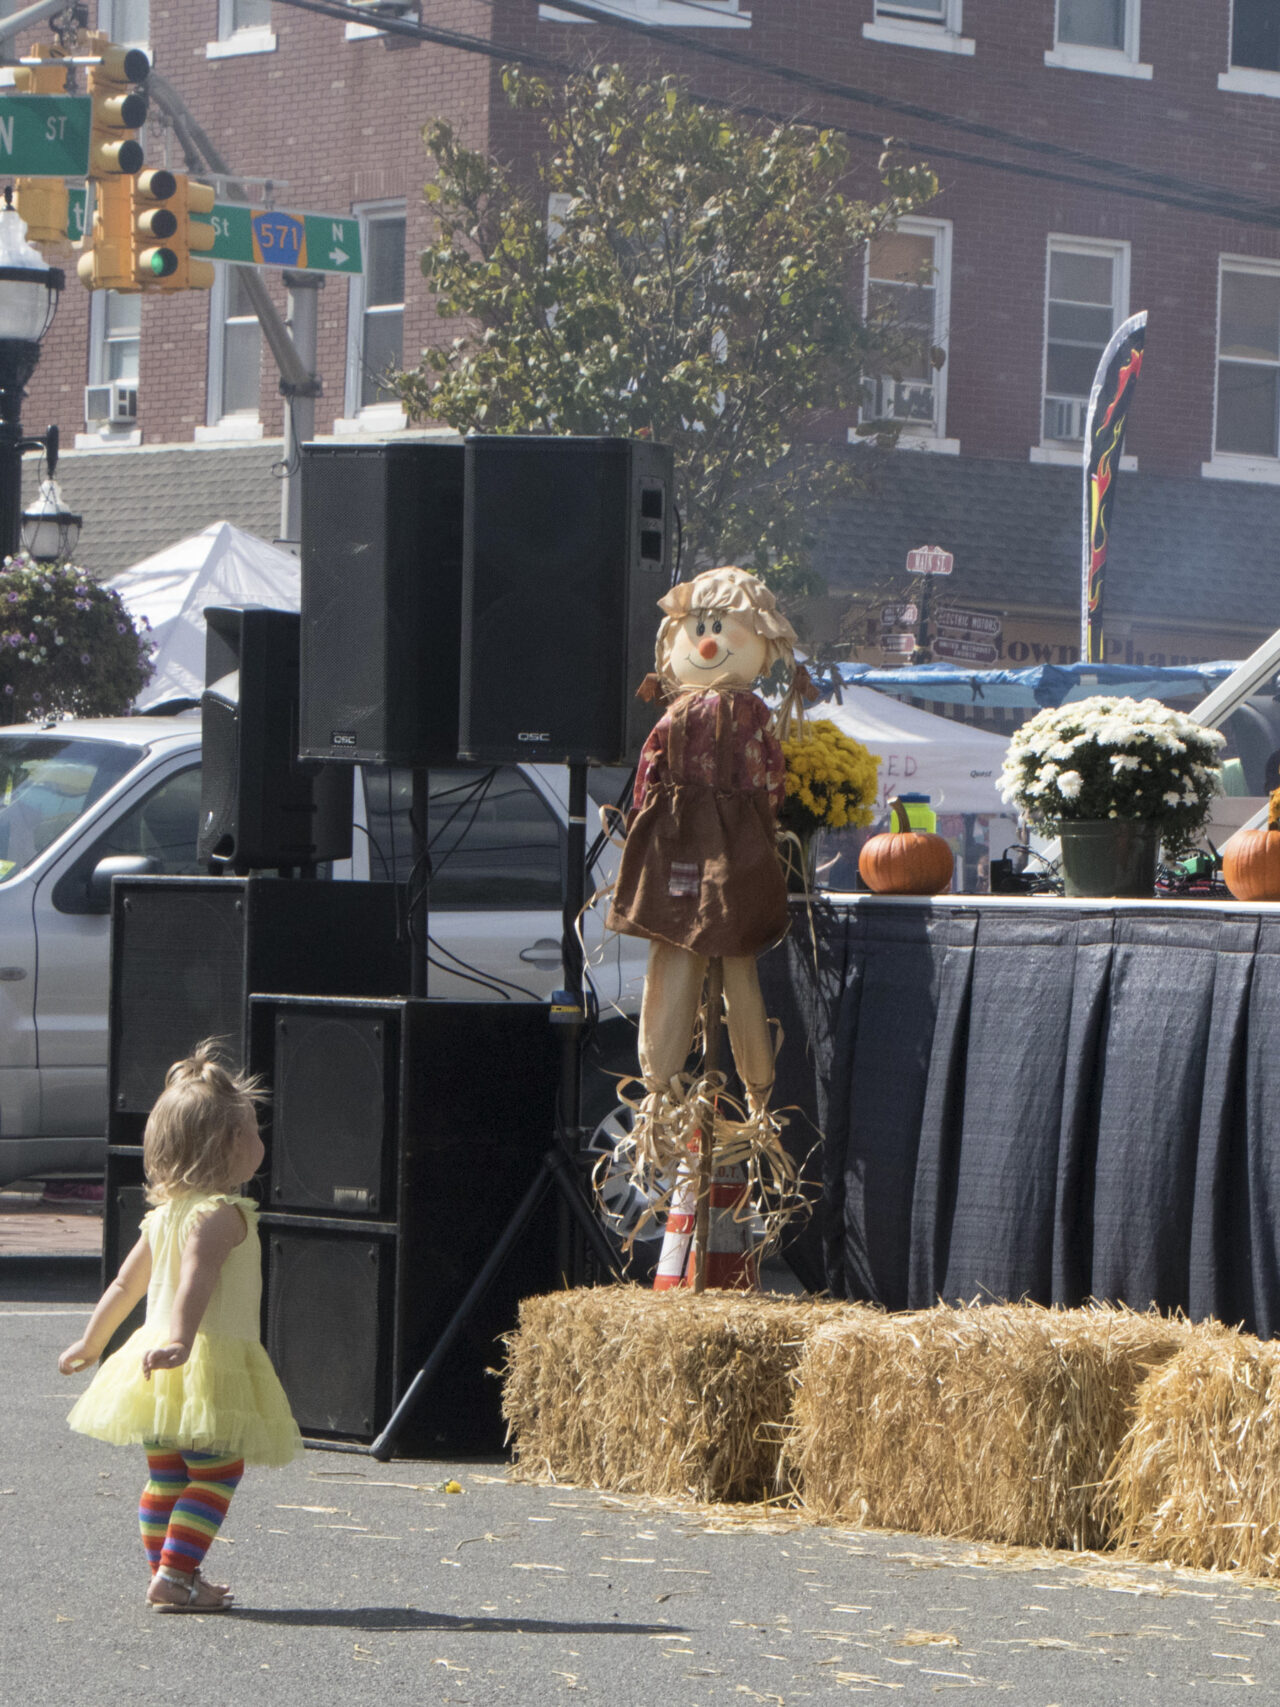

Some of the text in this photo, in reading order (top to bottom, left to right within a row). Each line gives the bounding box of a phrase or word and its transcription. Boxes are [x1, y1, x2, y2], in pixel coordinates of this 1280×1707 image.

[46, 116, 67, 140] ST
[211, 216, 229, 237] St
[261, 223, 298, 250] 571
[332, 223, 344, 242] N
[915, 554, 932, 570] MAIN
[996, 632, 1080, 664] town
[333, 735, 355, 744] QSC
[518, 732, 551, 741] QSC
